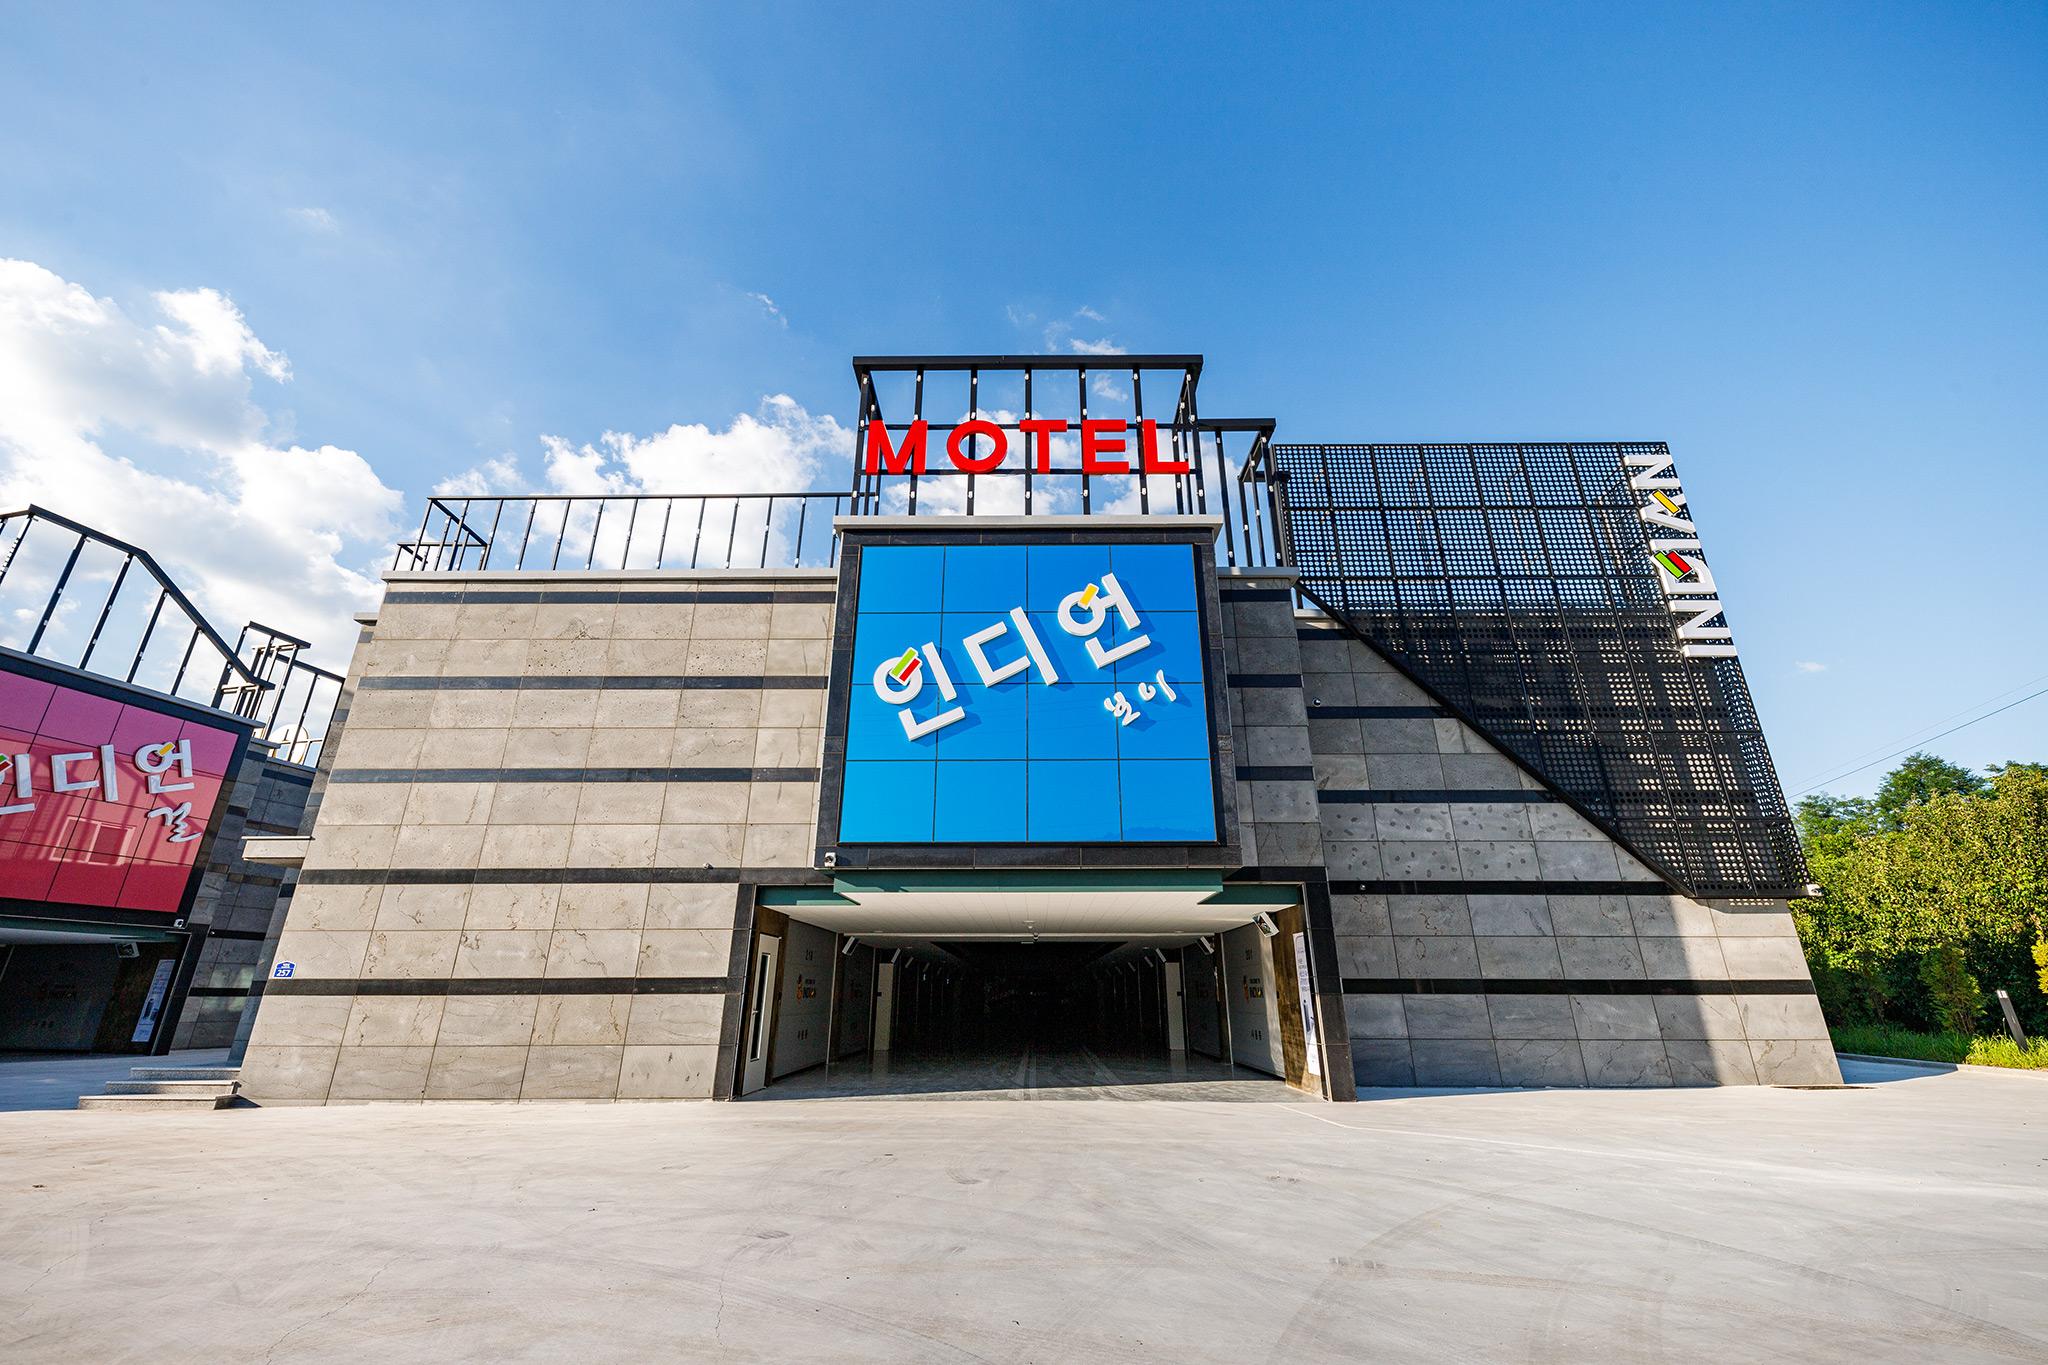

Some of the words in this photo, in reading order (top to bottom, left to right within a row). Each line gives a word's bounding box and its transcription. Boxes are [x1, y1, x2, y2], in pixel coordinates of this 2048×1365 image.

[865, 419, 1190, 475] MOTEL
[1624, 454, 1738, 657] INDIAN
[873, 573, 1151, 741] 인디언
[276, 969, 292, 977] 257
